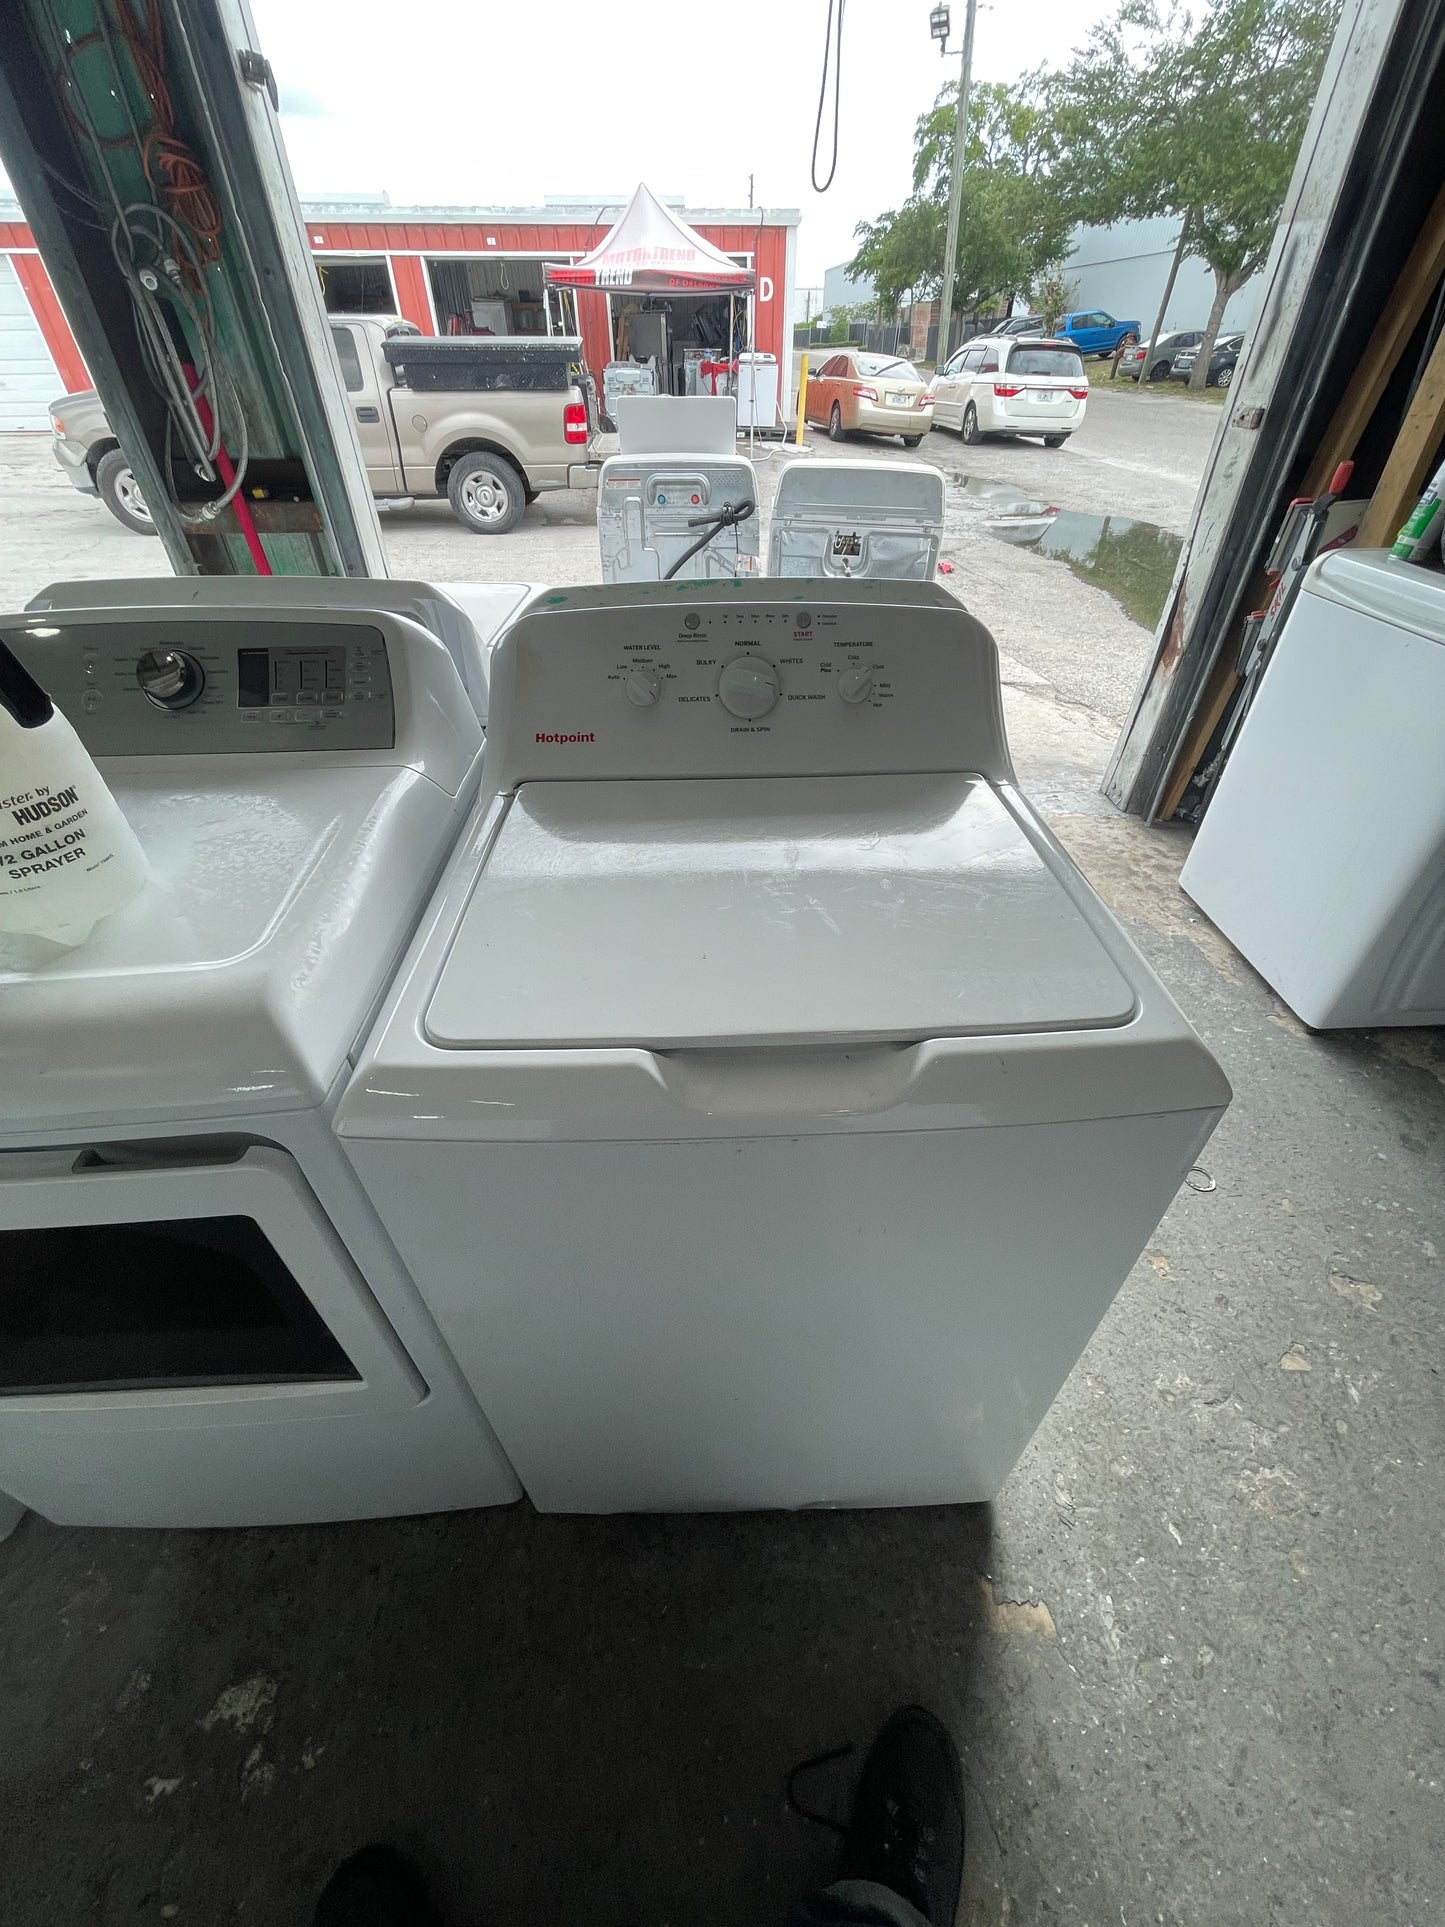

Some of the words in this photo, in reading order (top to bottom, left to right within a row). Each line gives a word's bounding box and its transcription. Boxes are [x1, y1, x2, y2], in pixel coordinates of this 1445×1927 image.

[760, 277, 774, 302] D
[535, 732, 595, 744] Hotpoint
[11, 786, 79, 826] HUDSON
[35, 786, 50, 797] by
[9, 830, 43, 845] HOME
[54, 808, 89, 830] GARDEN
[20, 828, 87, 860] GALLON
[8, 847, 87, 880] SPRAYER
